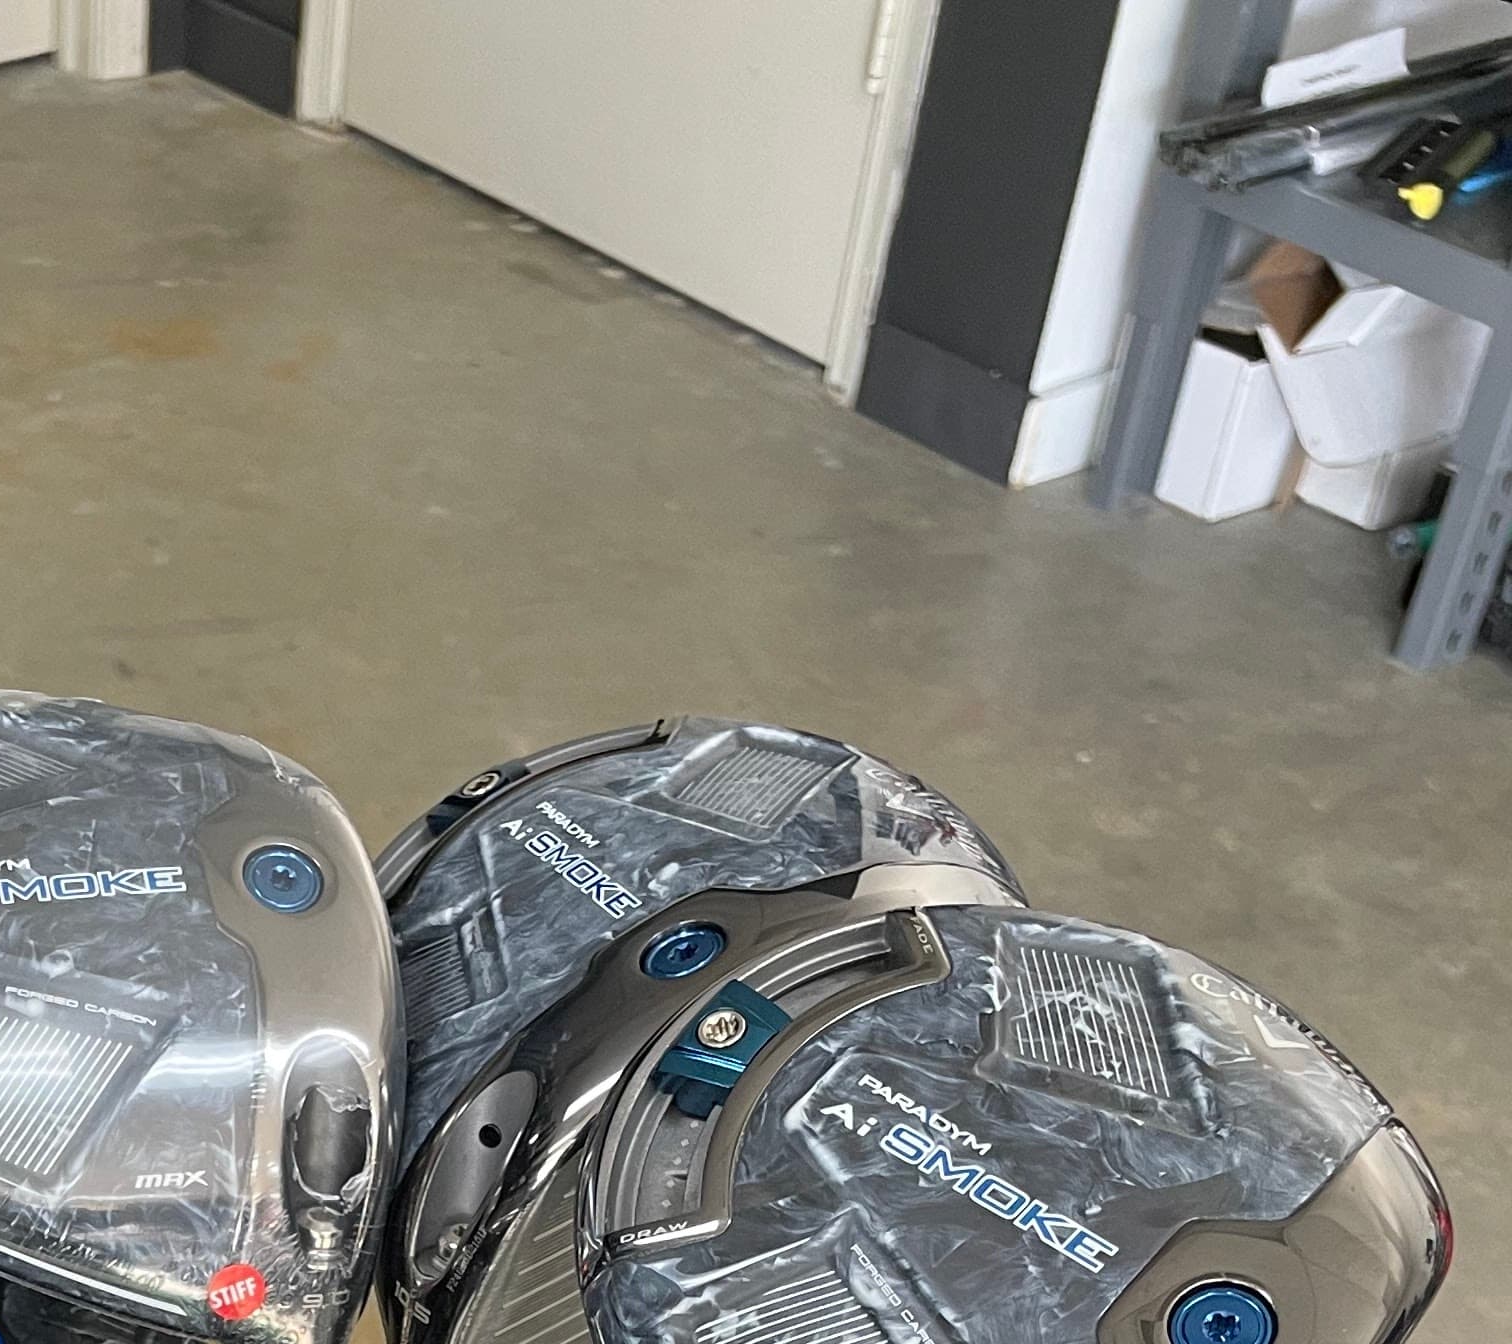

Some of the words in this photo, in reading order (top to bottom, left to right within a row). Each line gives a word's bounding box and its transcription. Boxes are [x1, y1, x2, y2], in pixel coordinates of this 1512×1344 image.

[535, 799, 601, 849] PARADYM
[500, 817, 531, 842] Ai
[524, 828, 644, 920] SMOKE
[909, 914, 934, 955] FADE
[4, 985, 78, 1010] FORGED
[84, 1001, 157, 1027] CARBON
[857, 1073, 992, 1156] PARADYM
[134, 1169, 209, 1189] MAX
[820, 1101, 880, 1138] Ai
[879, 1121, 1120, 1275] SMOKE
[619, 1220, 689, 1245] DRAW
[208, 1276, 257, 1309] STIFF
[849, 1243, 903, 1307] FORGED
